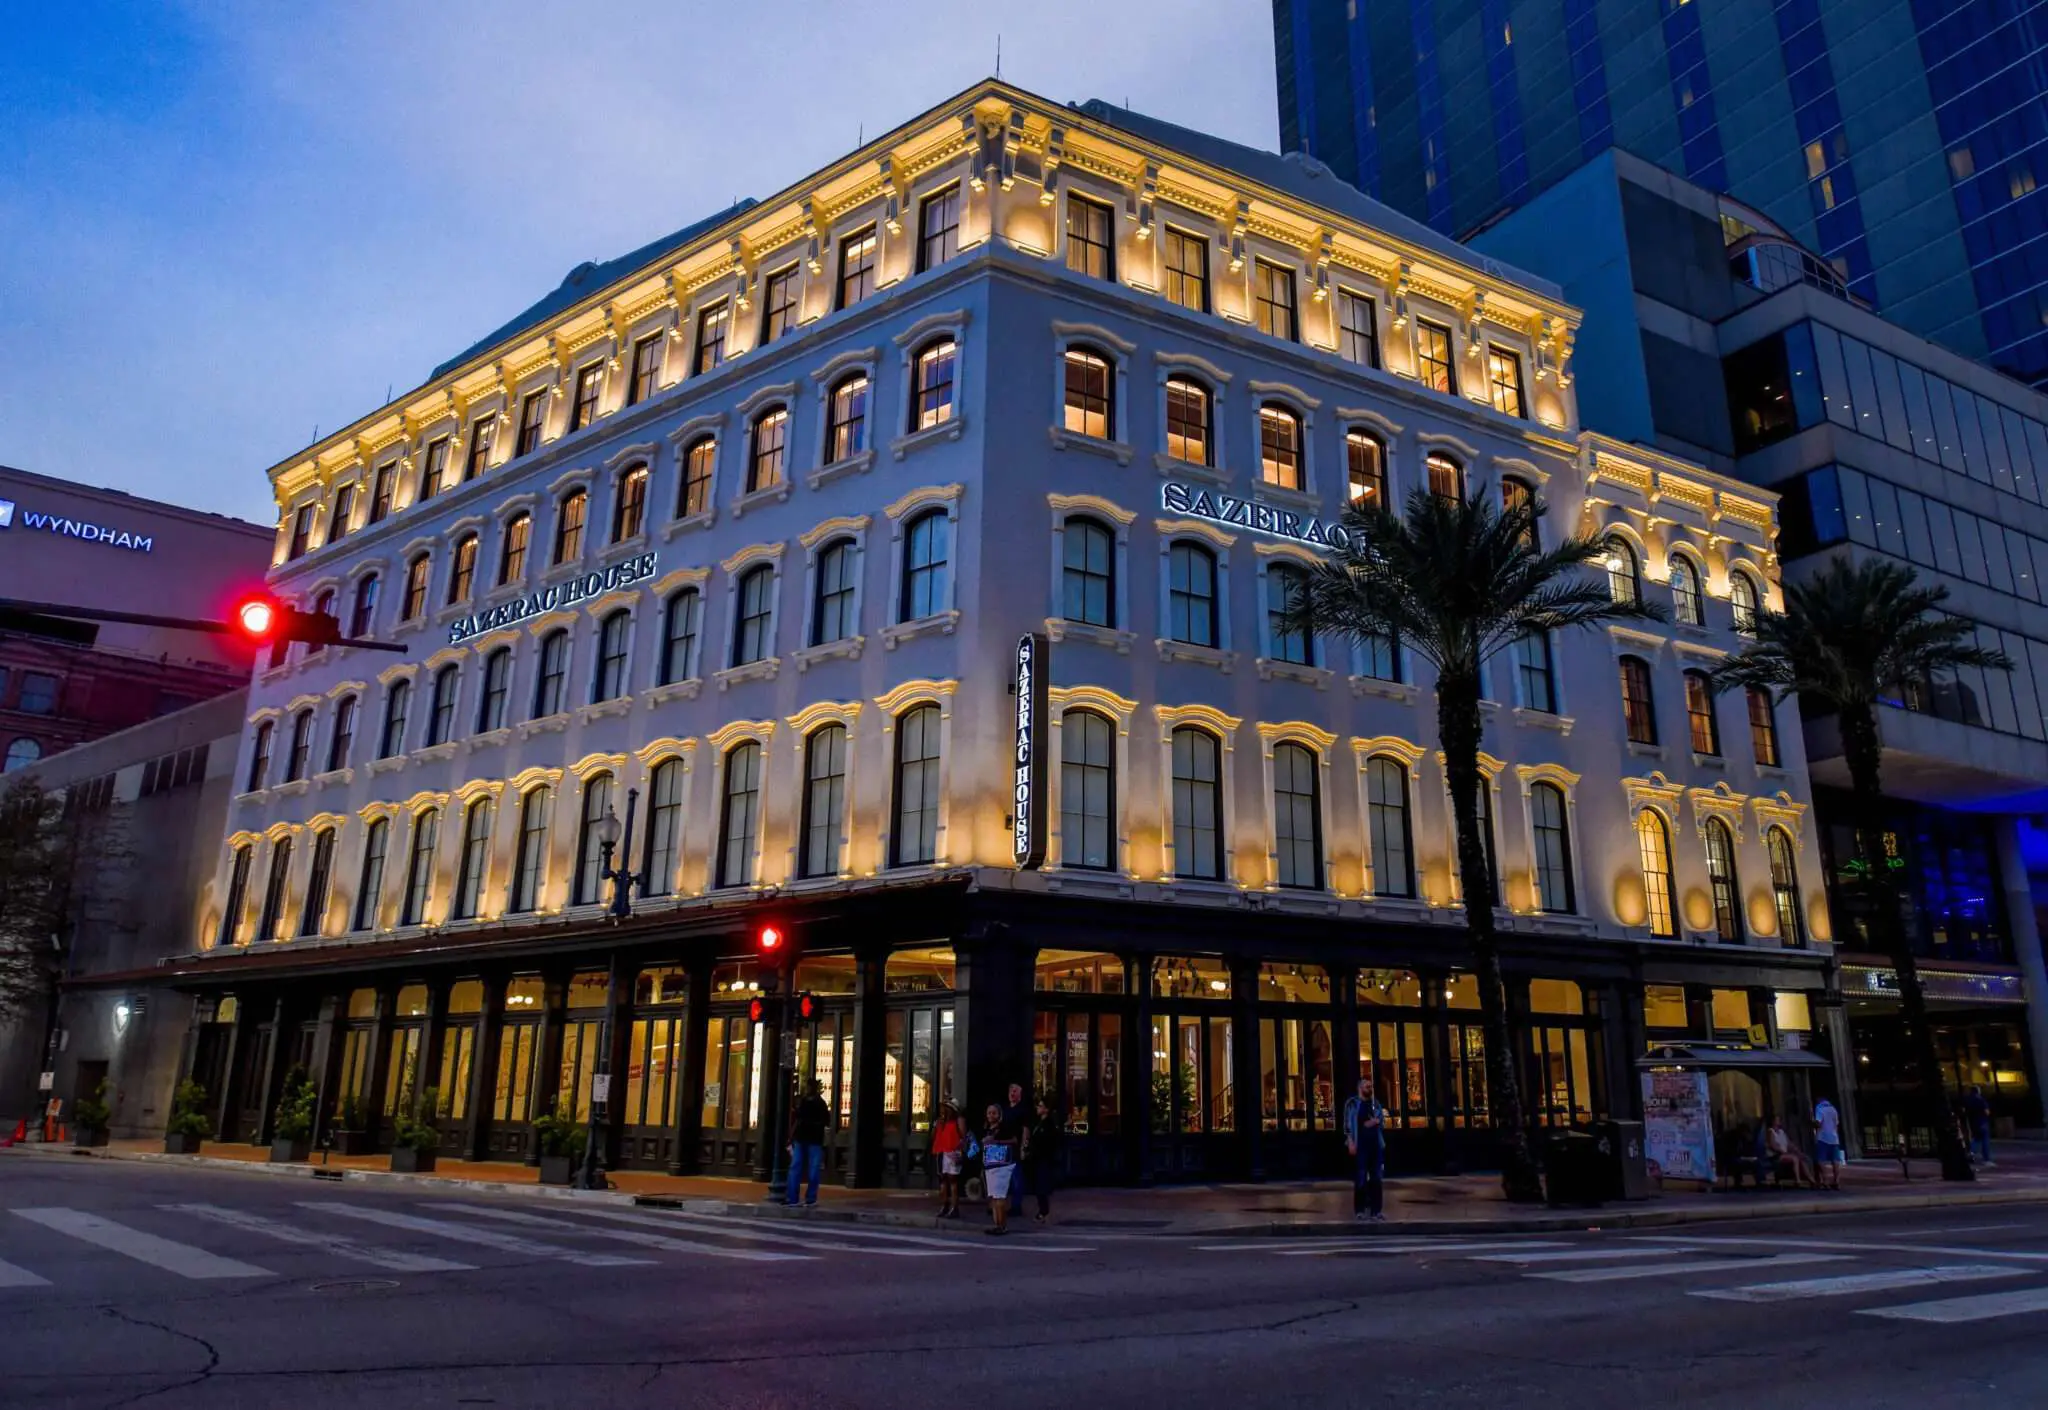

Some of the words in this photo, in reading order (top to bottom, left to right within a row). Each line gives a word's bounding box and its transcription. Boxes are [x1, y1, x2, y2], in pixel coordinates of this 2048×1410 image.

[23, 511, 153, 552] WYNDHAM
[1164, 482, 1352, 551] SAZERAC
[449, 585, 560, 644] SAZERAC
[561, 552, 658, 606] HOUSE
[1016, 646, 1031, 762] SAZERAC
[1015, 765, 1030, 855] HOUSE
